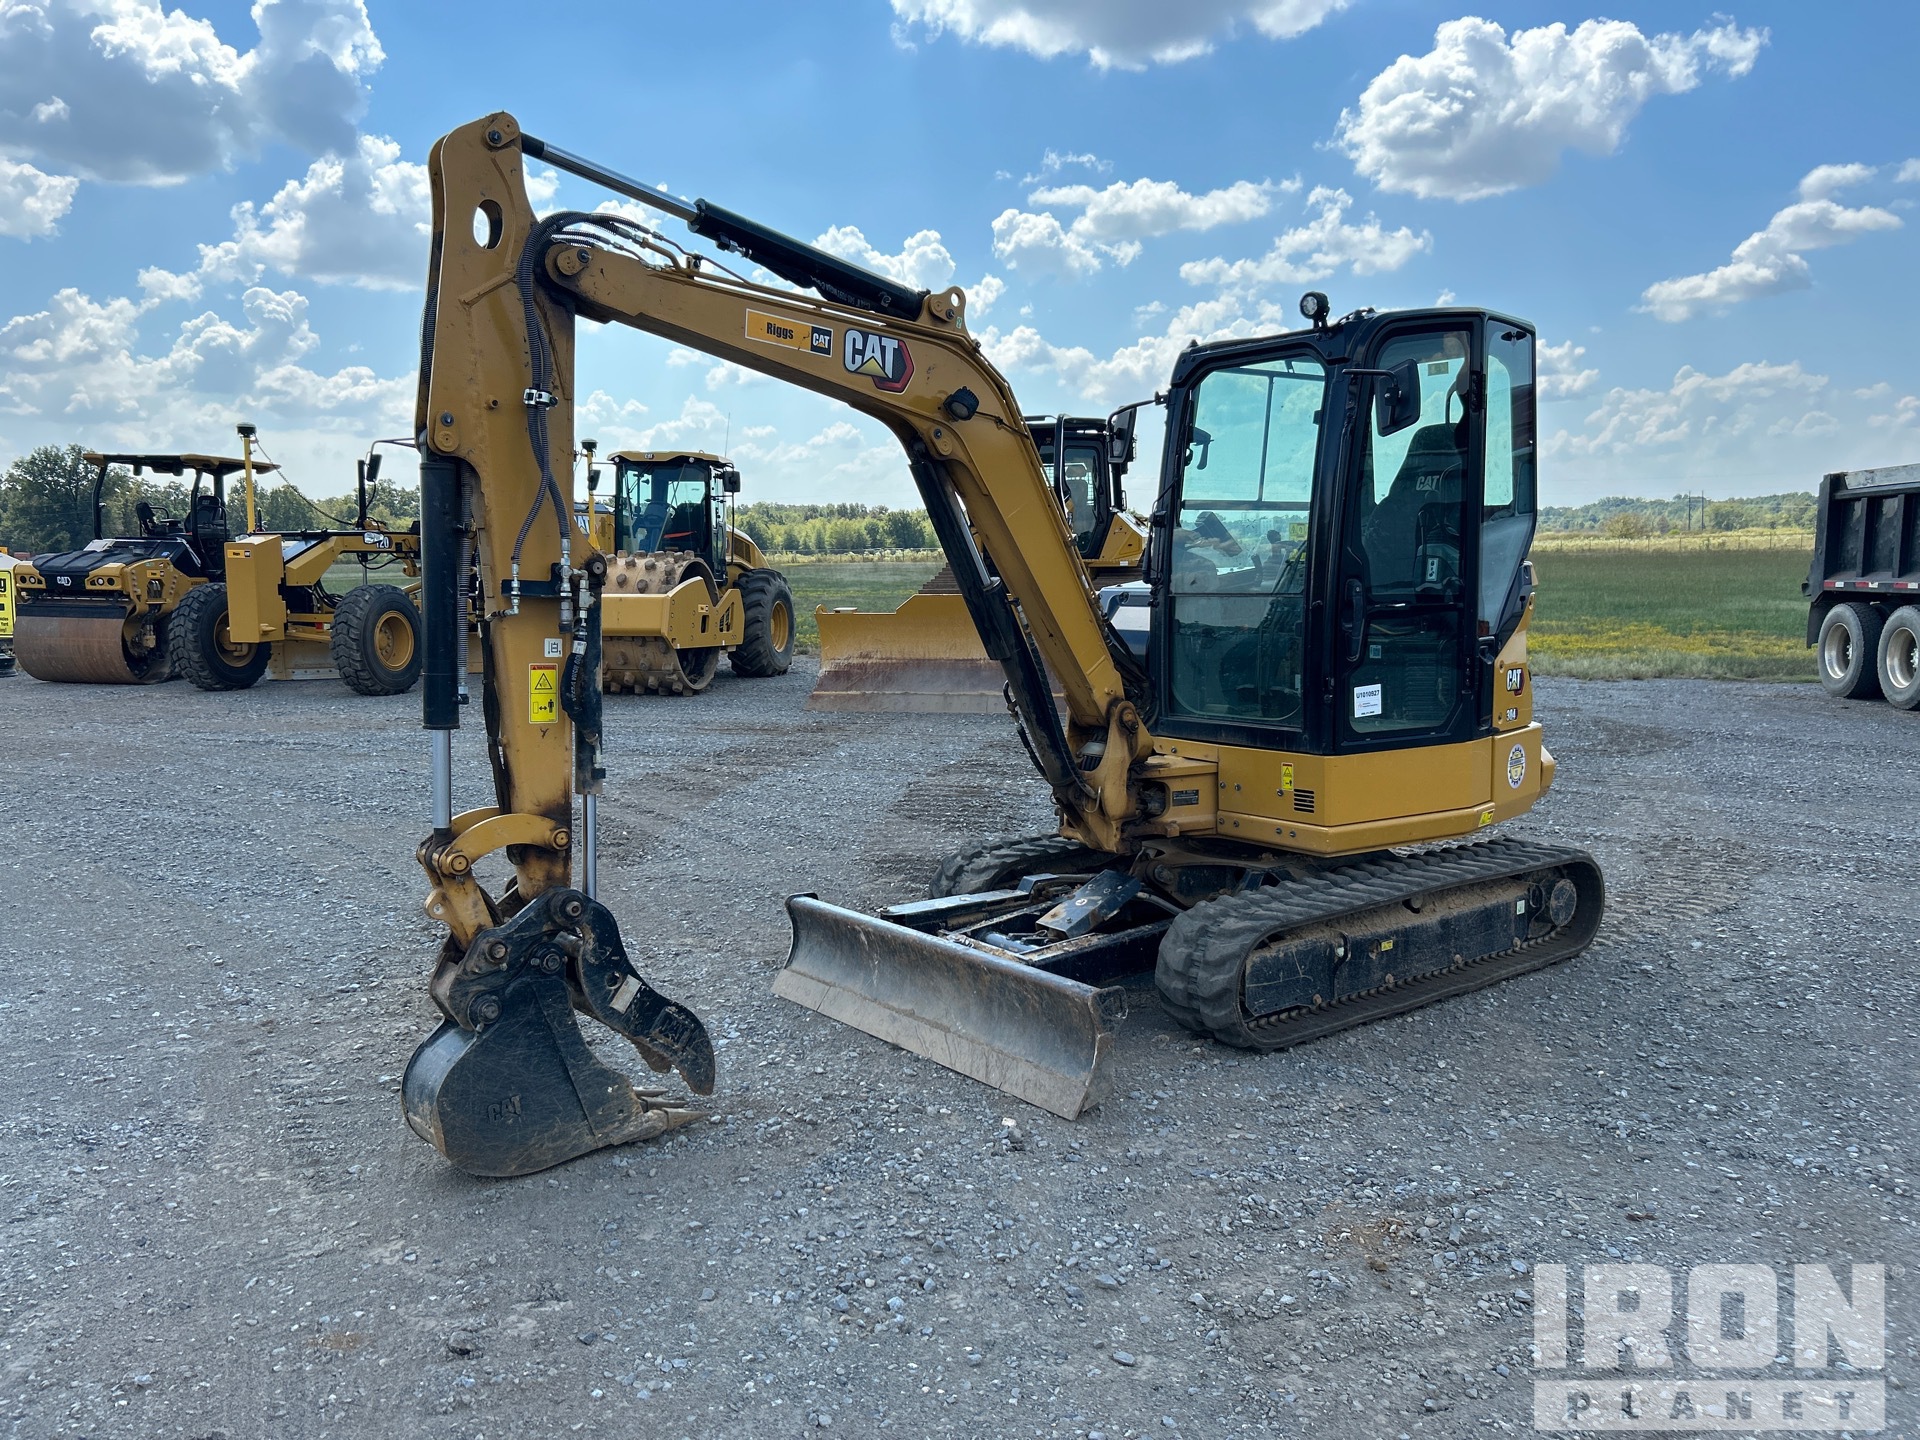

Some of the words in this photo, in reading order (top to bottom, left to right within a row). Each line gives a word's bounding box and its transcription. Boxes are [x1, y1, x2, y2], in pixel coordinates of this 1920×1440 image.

[766, 322, 794, 339] Riggs
[812, 333, 830, 348] CAT
[845, 329, 898, 379] CAT
[1416, 475, 1440, 491] CAT
[1506, 669, 1522, 691] CAT
[1506, 708, 1517, 721] 304
[487, 1094, 522, 1123] CAT
